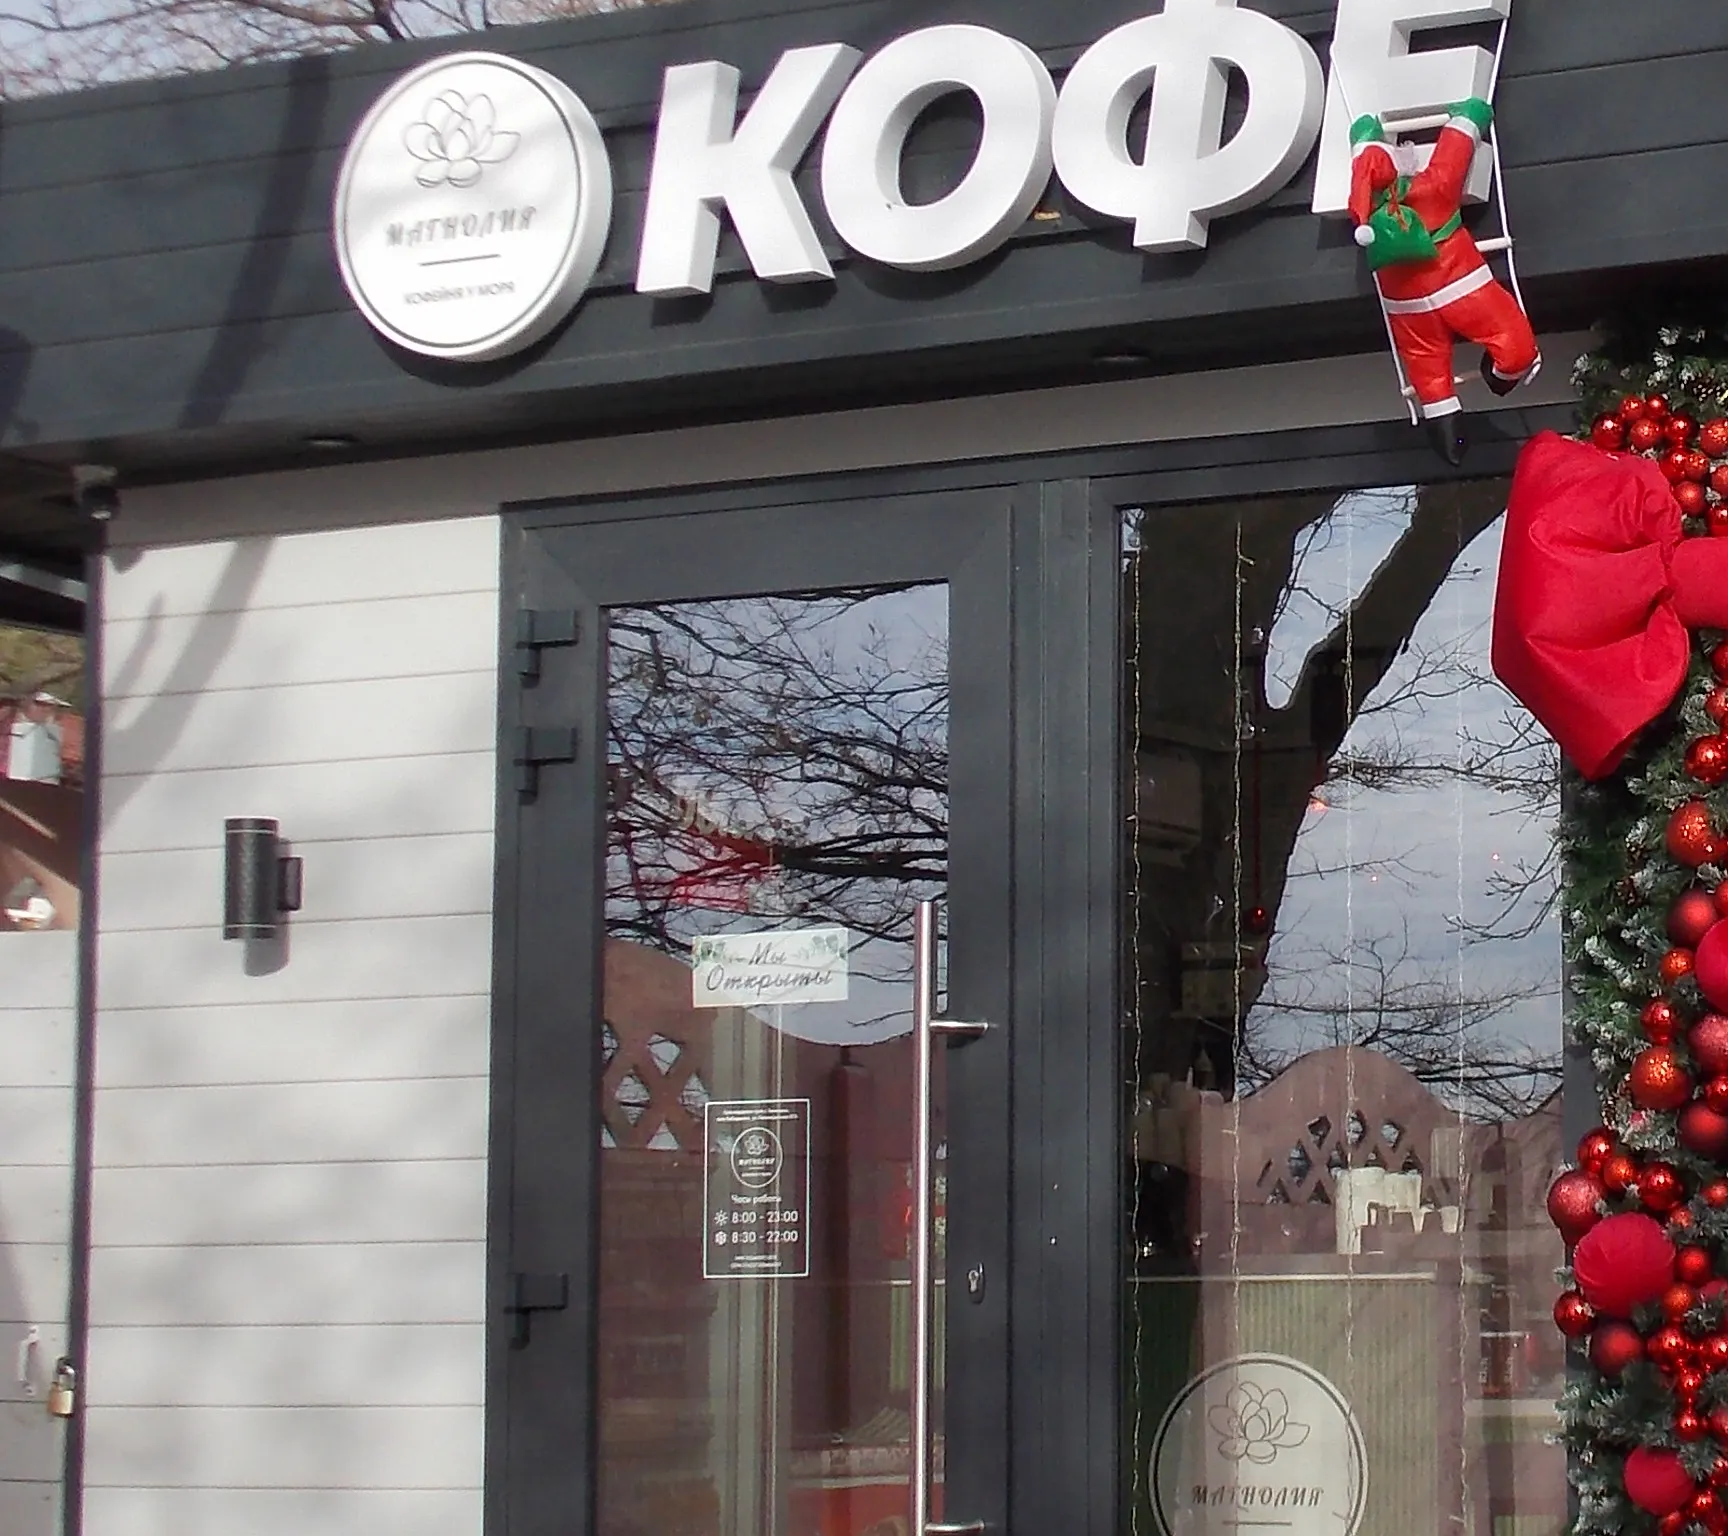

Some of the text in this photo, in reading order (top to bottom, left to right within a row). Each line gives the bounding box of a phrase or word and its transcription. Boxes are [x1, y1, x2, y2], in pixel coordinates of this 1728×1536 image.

[386, 205, 537, 247] МАГНОЛИЯ
[748, 941, 788, 966] Мы
[706, 963, 833, 996] Открыты
[731, 1210, 757, 1224] 8:00
[766, 1209, 799, 1224] 23:00
[731, 1230, 757, 1244] 8:30
[766, 1229, 799, 1244] 22:00
[1191, 1485, 1325, 1507] МАГНОЛИЯ
